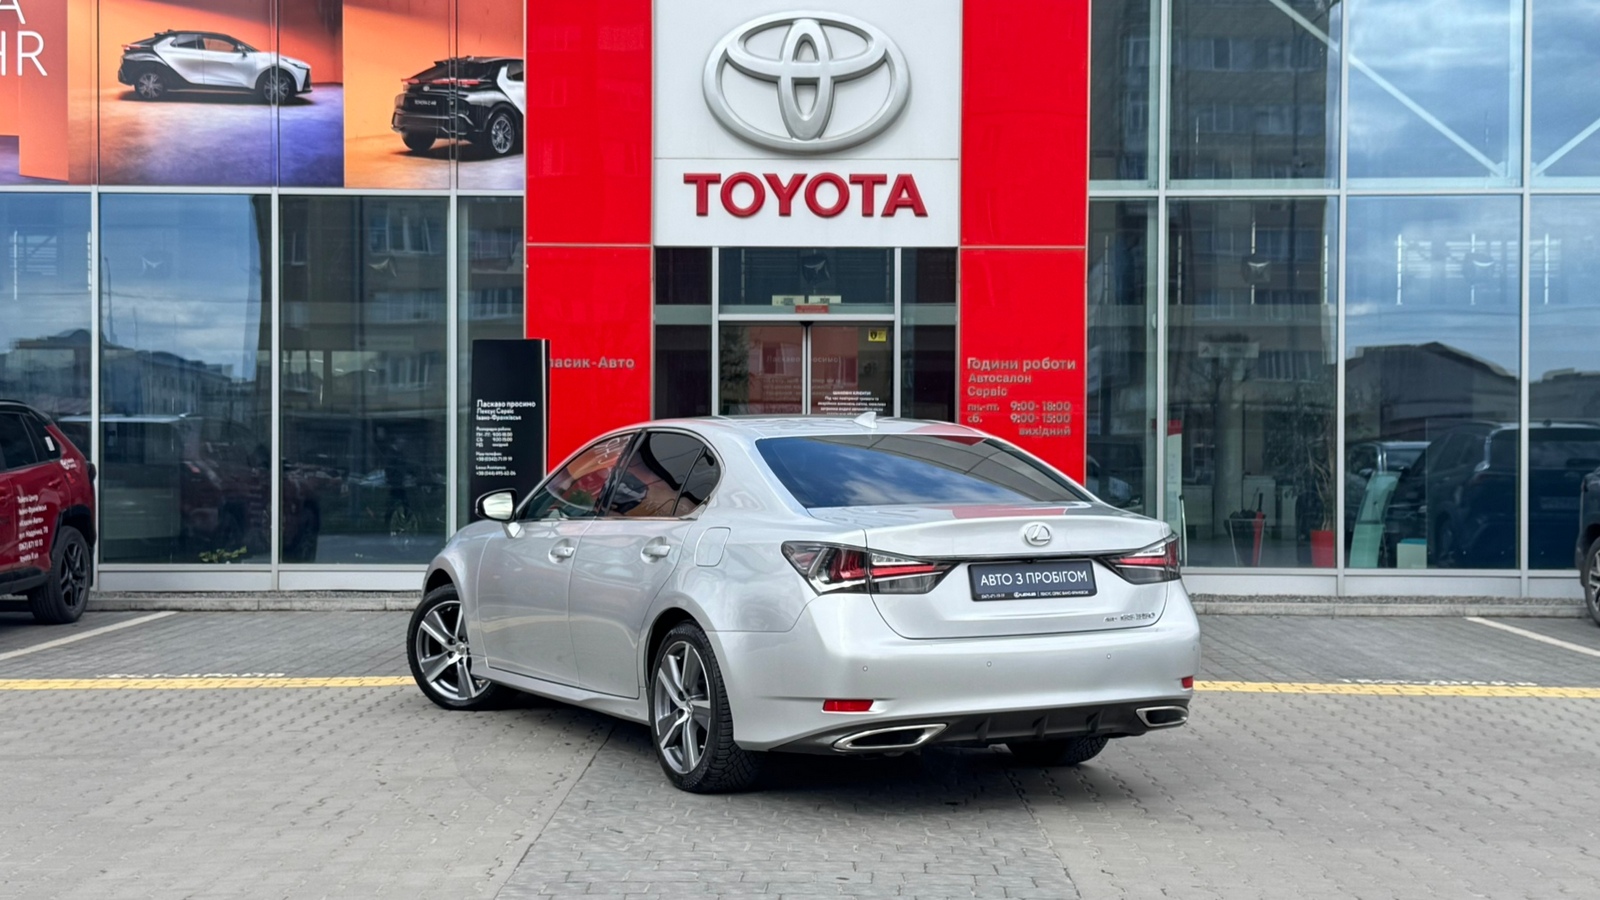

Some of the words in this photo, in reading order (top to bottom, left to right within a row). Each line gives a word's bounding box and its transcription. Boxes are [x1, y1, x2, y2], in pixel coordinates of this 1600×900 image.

[683, 171, 928, 218] TOYOTA
[967, 357, 1019, 371] Години
[1022, 357, 1076, 372] роботи
[968, 374, 1032, 383] Автосалон
[967, 386, 1008, 398] Сервіс
[506, 401, 536, 409] просимо
[1019, 426, 1071, 437] вихідний
[980, 573, 1013, 587] АВТО
[1015, 572, 1024, 585] З
[1026, 570, 1088, 585] ПРОБІГОМ
